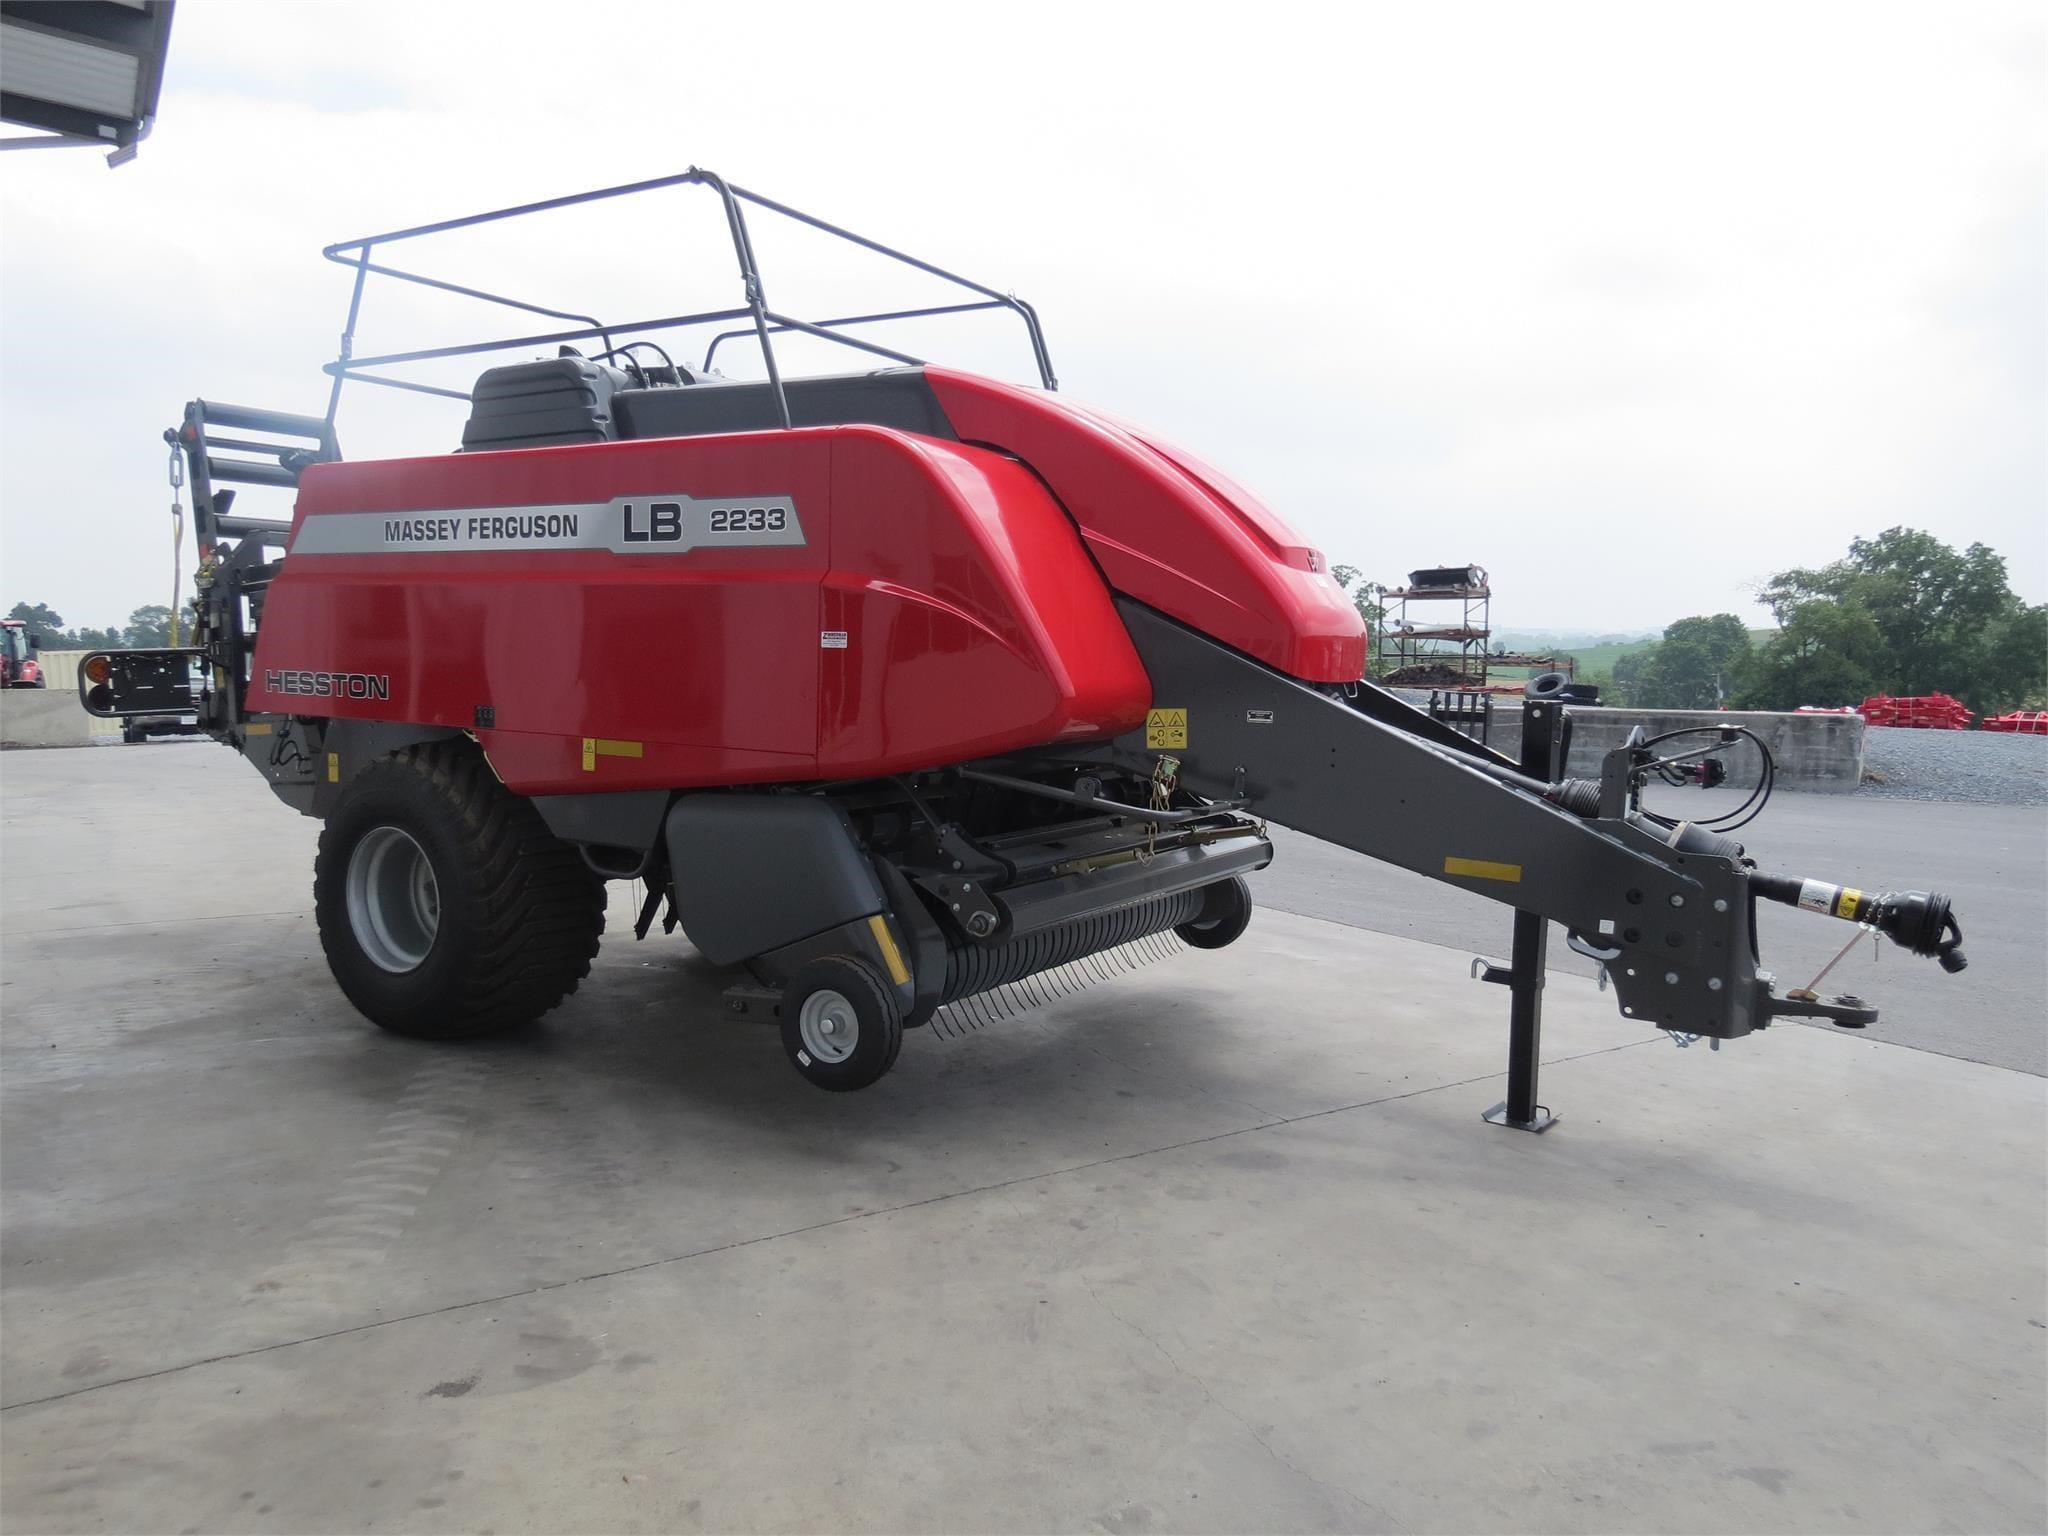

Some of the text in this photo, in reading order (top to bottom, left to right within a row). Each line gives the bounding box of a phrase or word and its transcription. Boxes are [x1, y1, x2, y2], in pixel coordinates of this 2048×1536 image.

[384, 502, 787, 542] MASSEY FERGUSON LB 2233
[265, 669, 389, 700] HESSTON
